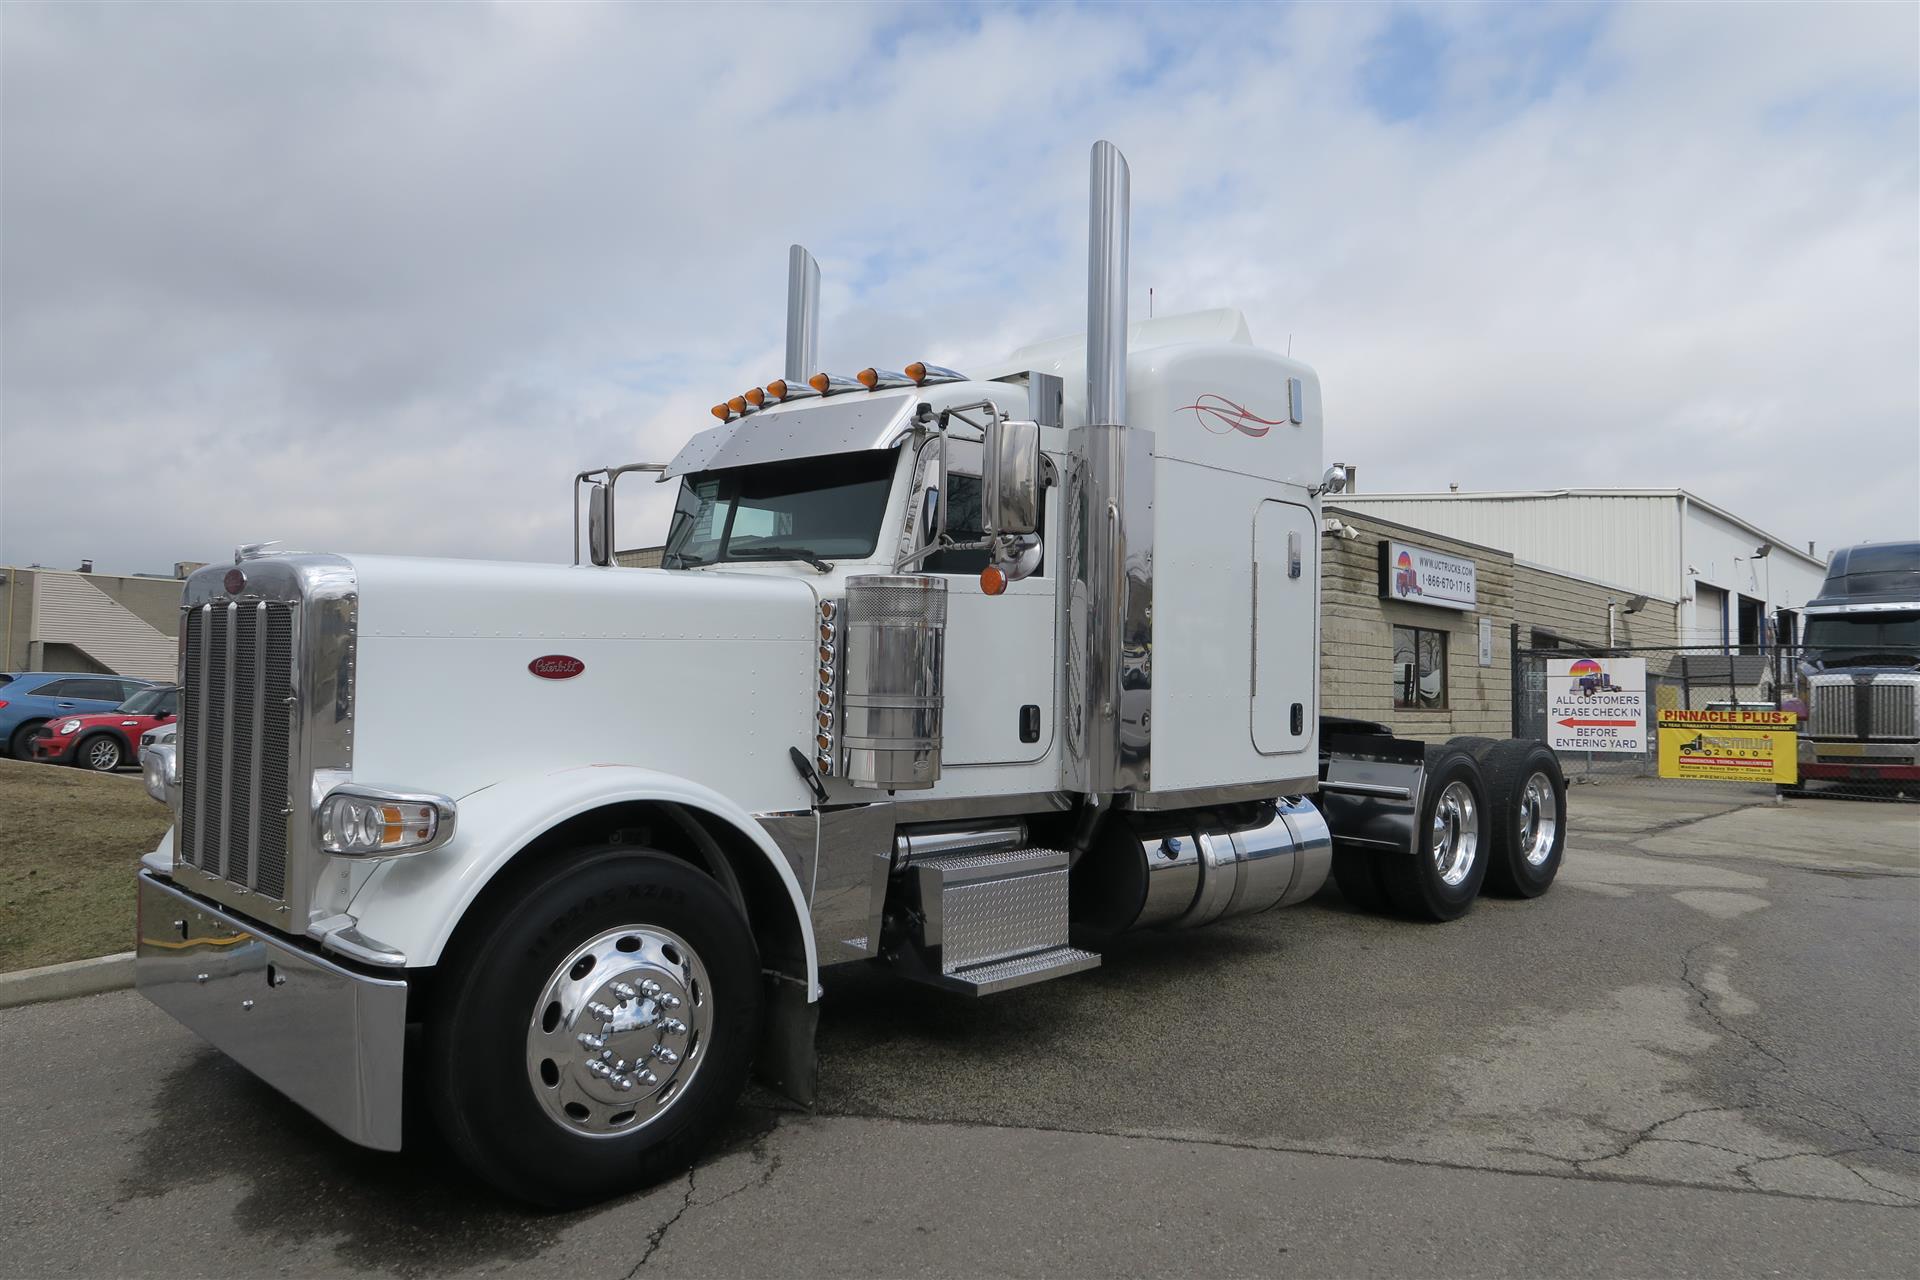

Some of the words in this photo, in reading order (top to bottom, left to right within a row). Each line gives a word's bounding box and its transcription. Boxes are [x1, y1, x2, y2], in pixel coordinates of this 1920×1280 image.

[1419, 557, 1473, 576] WWW.UCTRUCKS.COM
[1422, 574, 1471, 593] 1-866-670-1716
[1556, 696, 1575, 705] ALL
[1577, 696, 1640, 705] CUSTOMERS
[1552, 708, 1590, 716] PLEASE
[1592, 708, 1628, 717] CHECK
[1630, 708, 1641, 717] IN
[1664, 710, 1737, 722] PINNACLE
[1577, 728, 1618, 737] BEFORE
[1556, 739, 1607, 748] ENTERING
[1610, 740, 1637, 748] YARD
